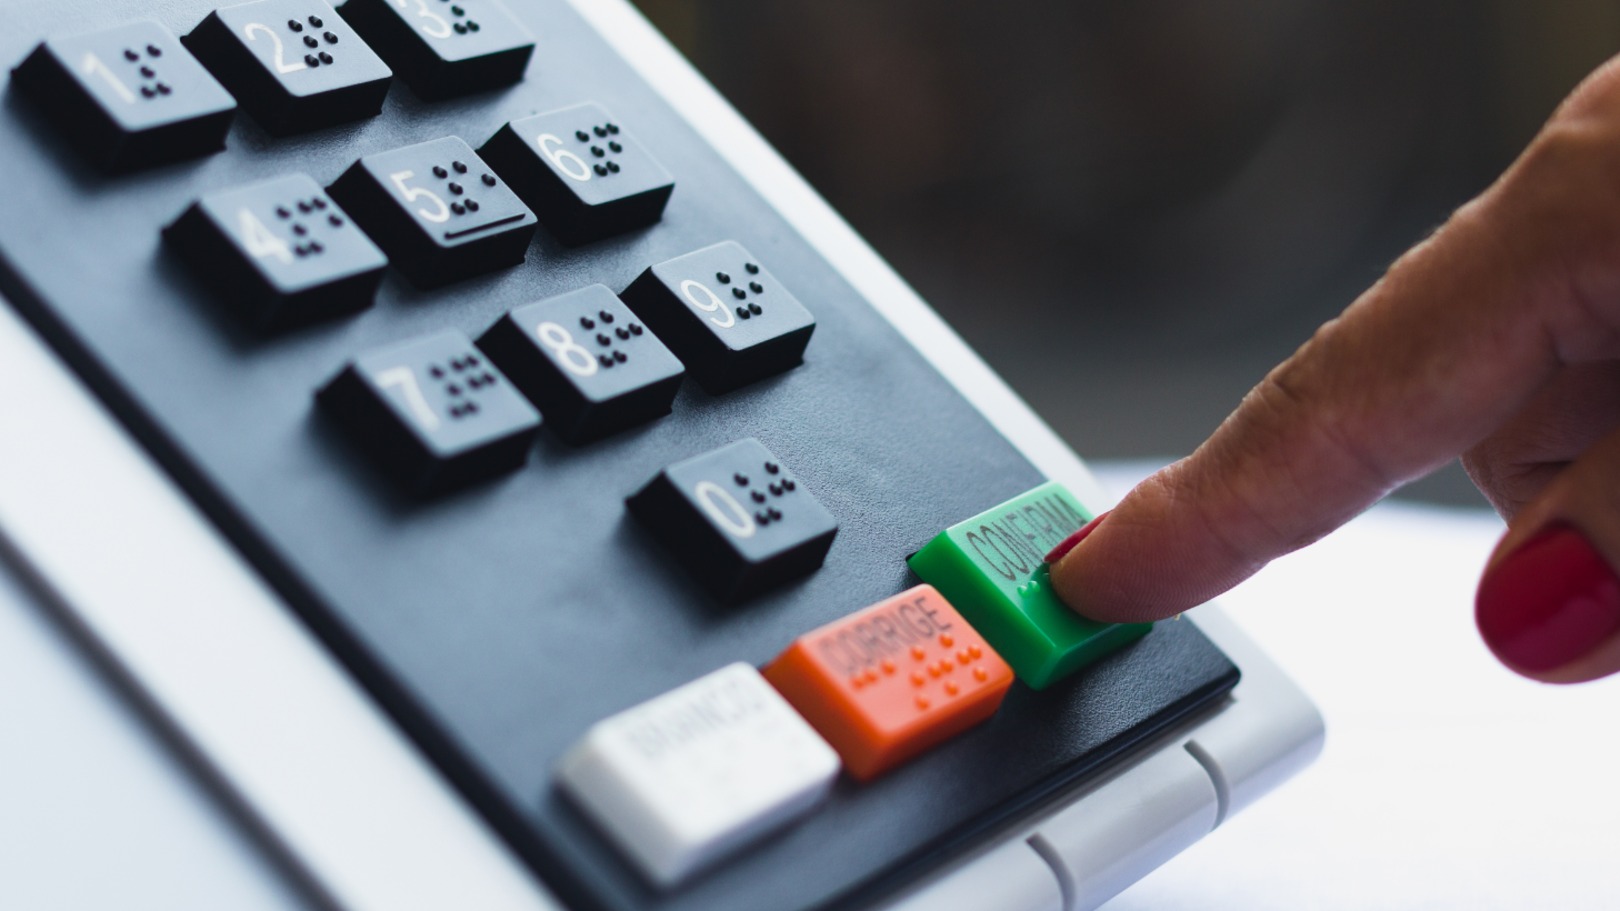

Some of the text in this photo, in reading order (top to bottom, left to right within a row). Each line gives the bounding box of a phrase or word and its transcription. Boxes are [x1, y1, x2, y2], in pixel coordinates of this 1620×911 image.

[398, 0, 452, 38] 3
[245, 22, 307, 74] 2
[82, 53, 135, 103] 1
[537, 133, 592, 182] 6
[390, 170, 450, 223] 5
[237, 208, 295, 265] 4
[680, 279, 735, 328] 9
[536, 321, 598, 377] 8
[376, 367, 440, 431] 7
[818, 597, 952, 676] CORRIGE
